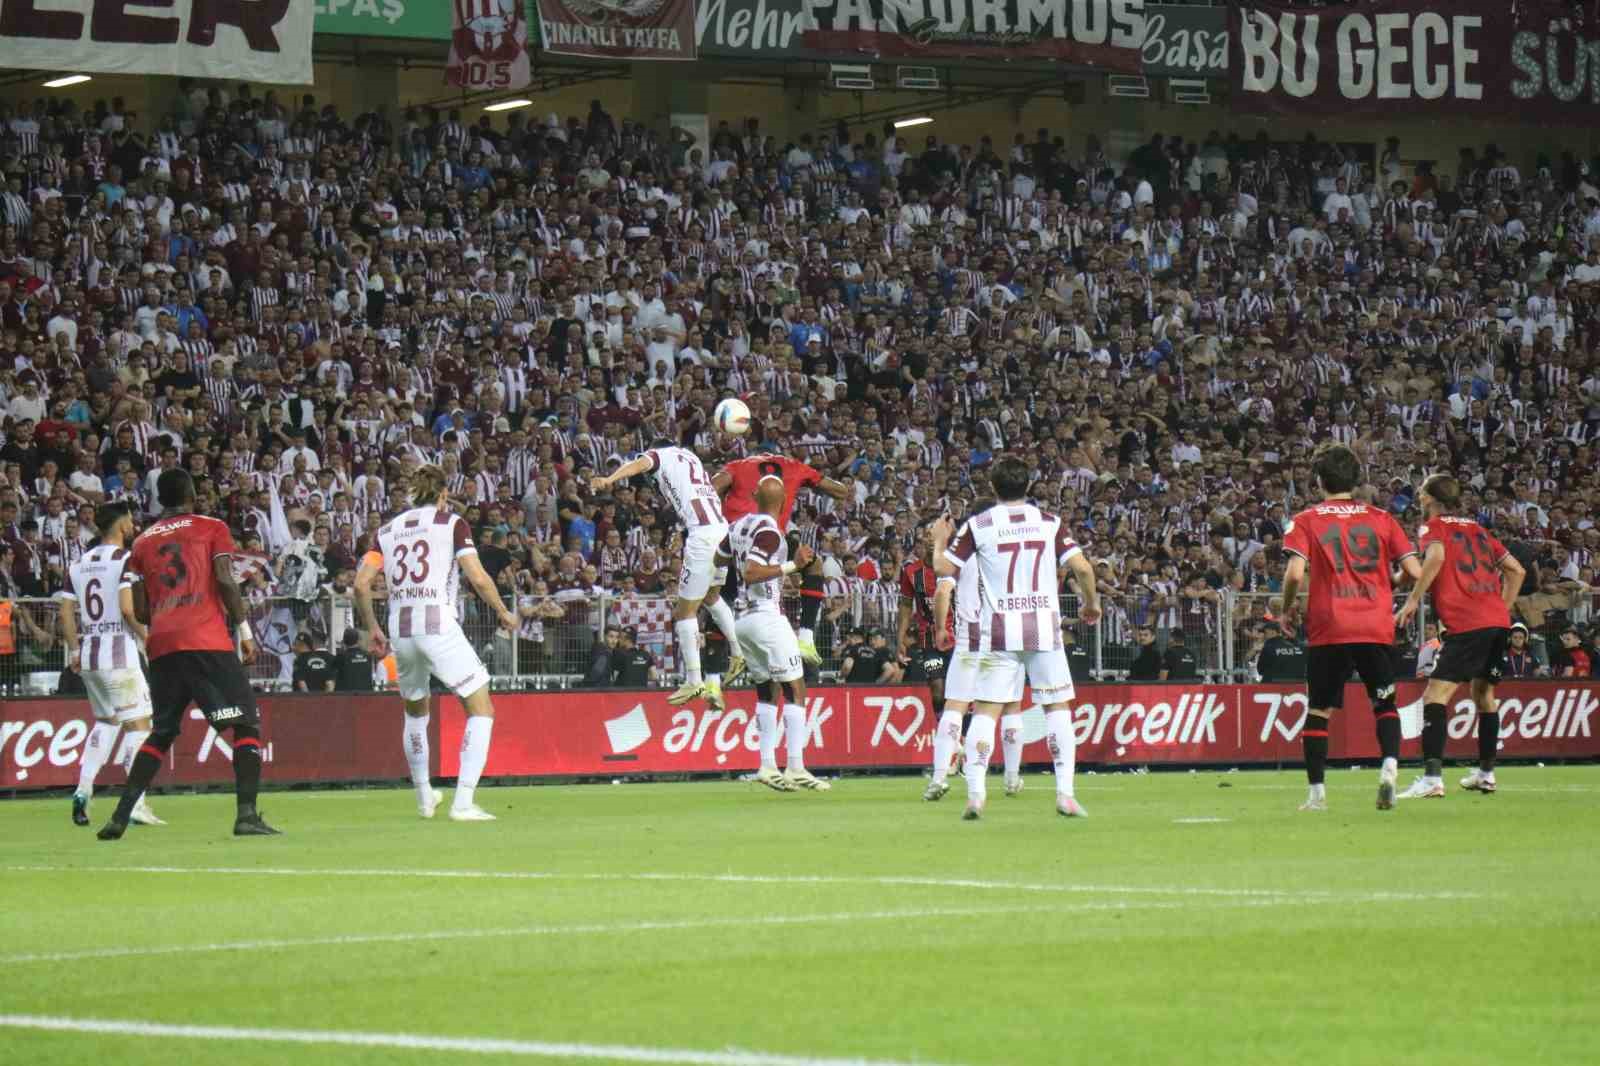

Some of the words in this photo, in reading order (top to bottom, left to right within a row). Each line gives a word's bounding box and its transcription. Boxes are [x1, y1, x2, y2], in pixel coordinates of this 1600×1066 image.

[622, 28, 681, 51] TAYFA
[1240, 7, 1319, 97] BU
[1336, 12, 1483, 100] GECE
[159, 543, 187, 589] 3
[392, 540, 429, 586] 33
[997, 541, 1045, 594] 77
[1320, 523, 1380, 573] 19
[85, 578, 104, 621] 6
[1071, 693, 1225, 756] arçelik
